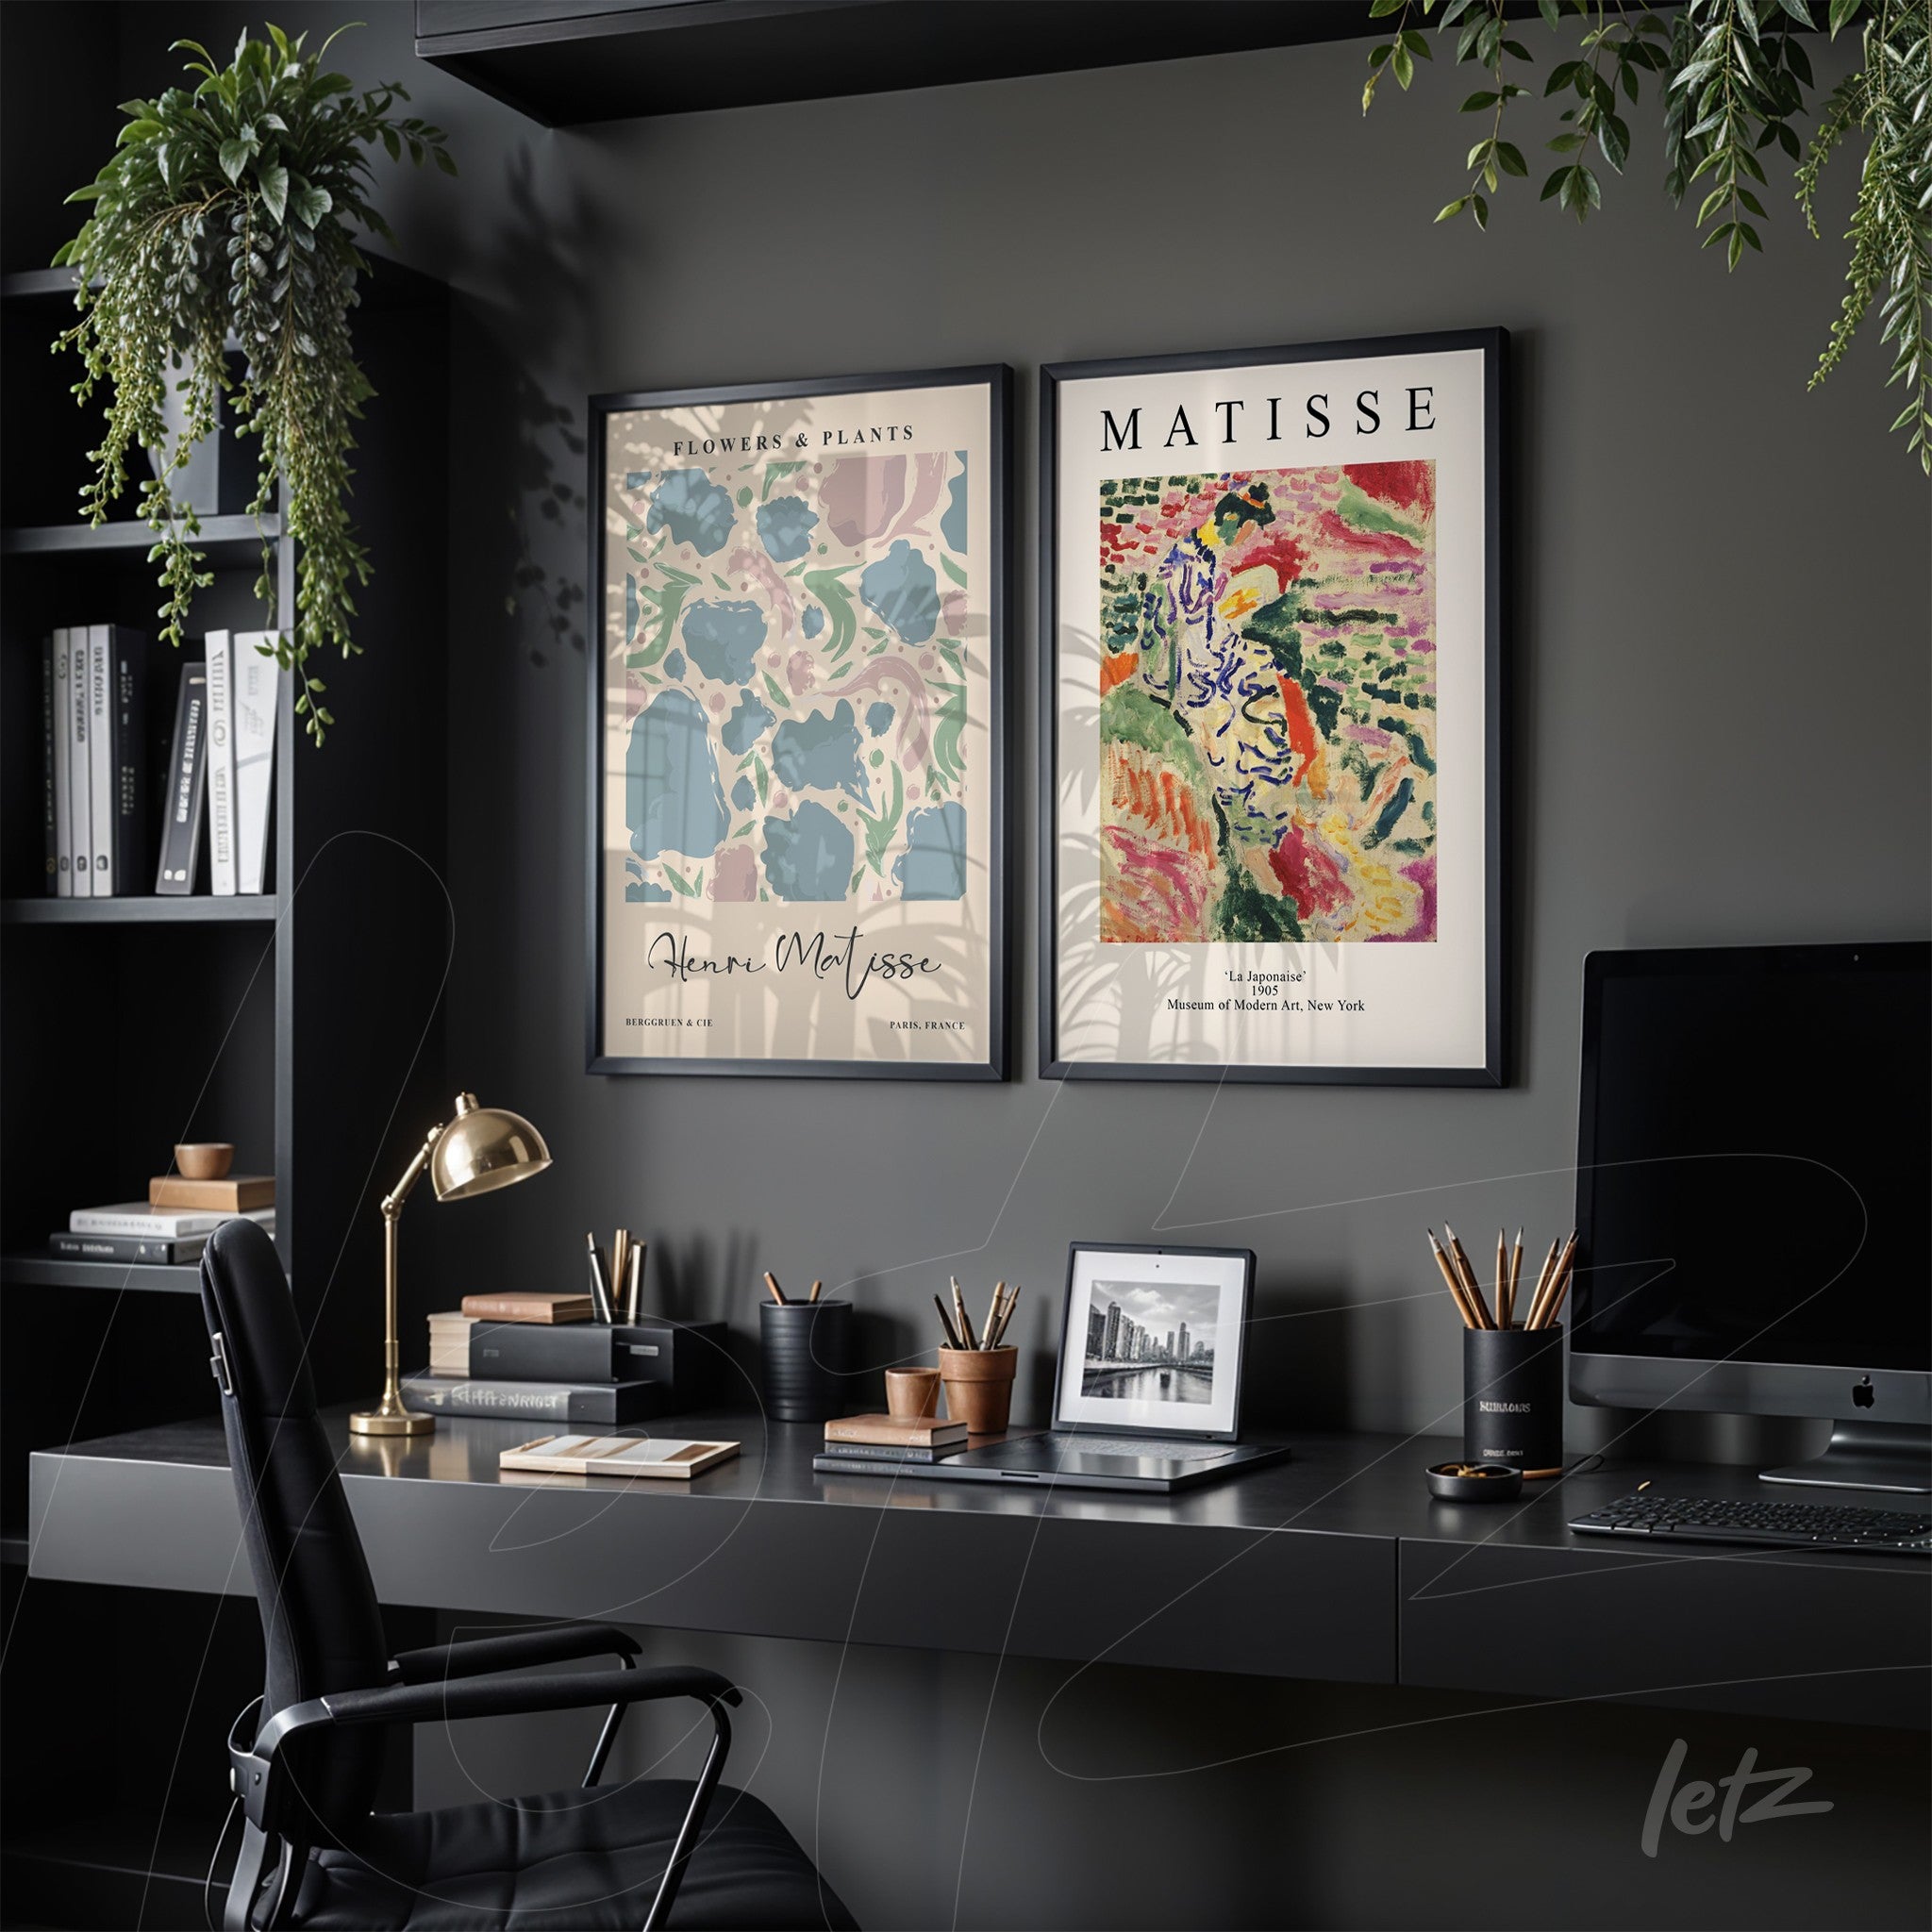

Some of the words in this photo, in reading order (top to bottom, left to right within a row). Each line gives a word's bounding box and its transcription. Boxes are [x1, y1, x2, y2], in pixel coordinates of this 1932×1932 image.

[1100, 387, 1437, 452] MATISSE
[674, 434, 782, 457] FLOWERS
[794, 432, 808, 448] &
[823, 425, 913, 446] PLANTS
[648, 932, 767, 983] Henri
[775, 925, 942, 1001] Matisse
[1252, 985, 1278, 996] 1905
[1167, 998, 1214, 1010] Museum
[1218, 998, 1232, 1010] of
[1234, 999, 1277, 1011] Modern
[1281, 999, 1304, 1012] Art,
[1307, 1000, 1333, 1011] New
[1338, 999, 1366, 1011] York
[625, 1018, 683, 1027] BERGGRUEN
[686, 1018, 694, 1027] &
[696, 1019, 713, 1027] CIE
[890, 1021, 922, 1030] PARIS,
[924, 1021, 965, 1030] FRANCE
